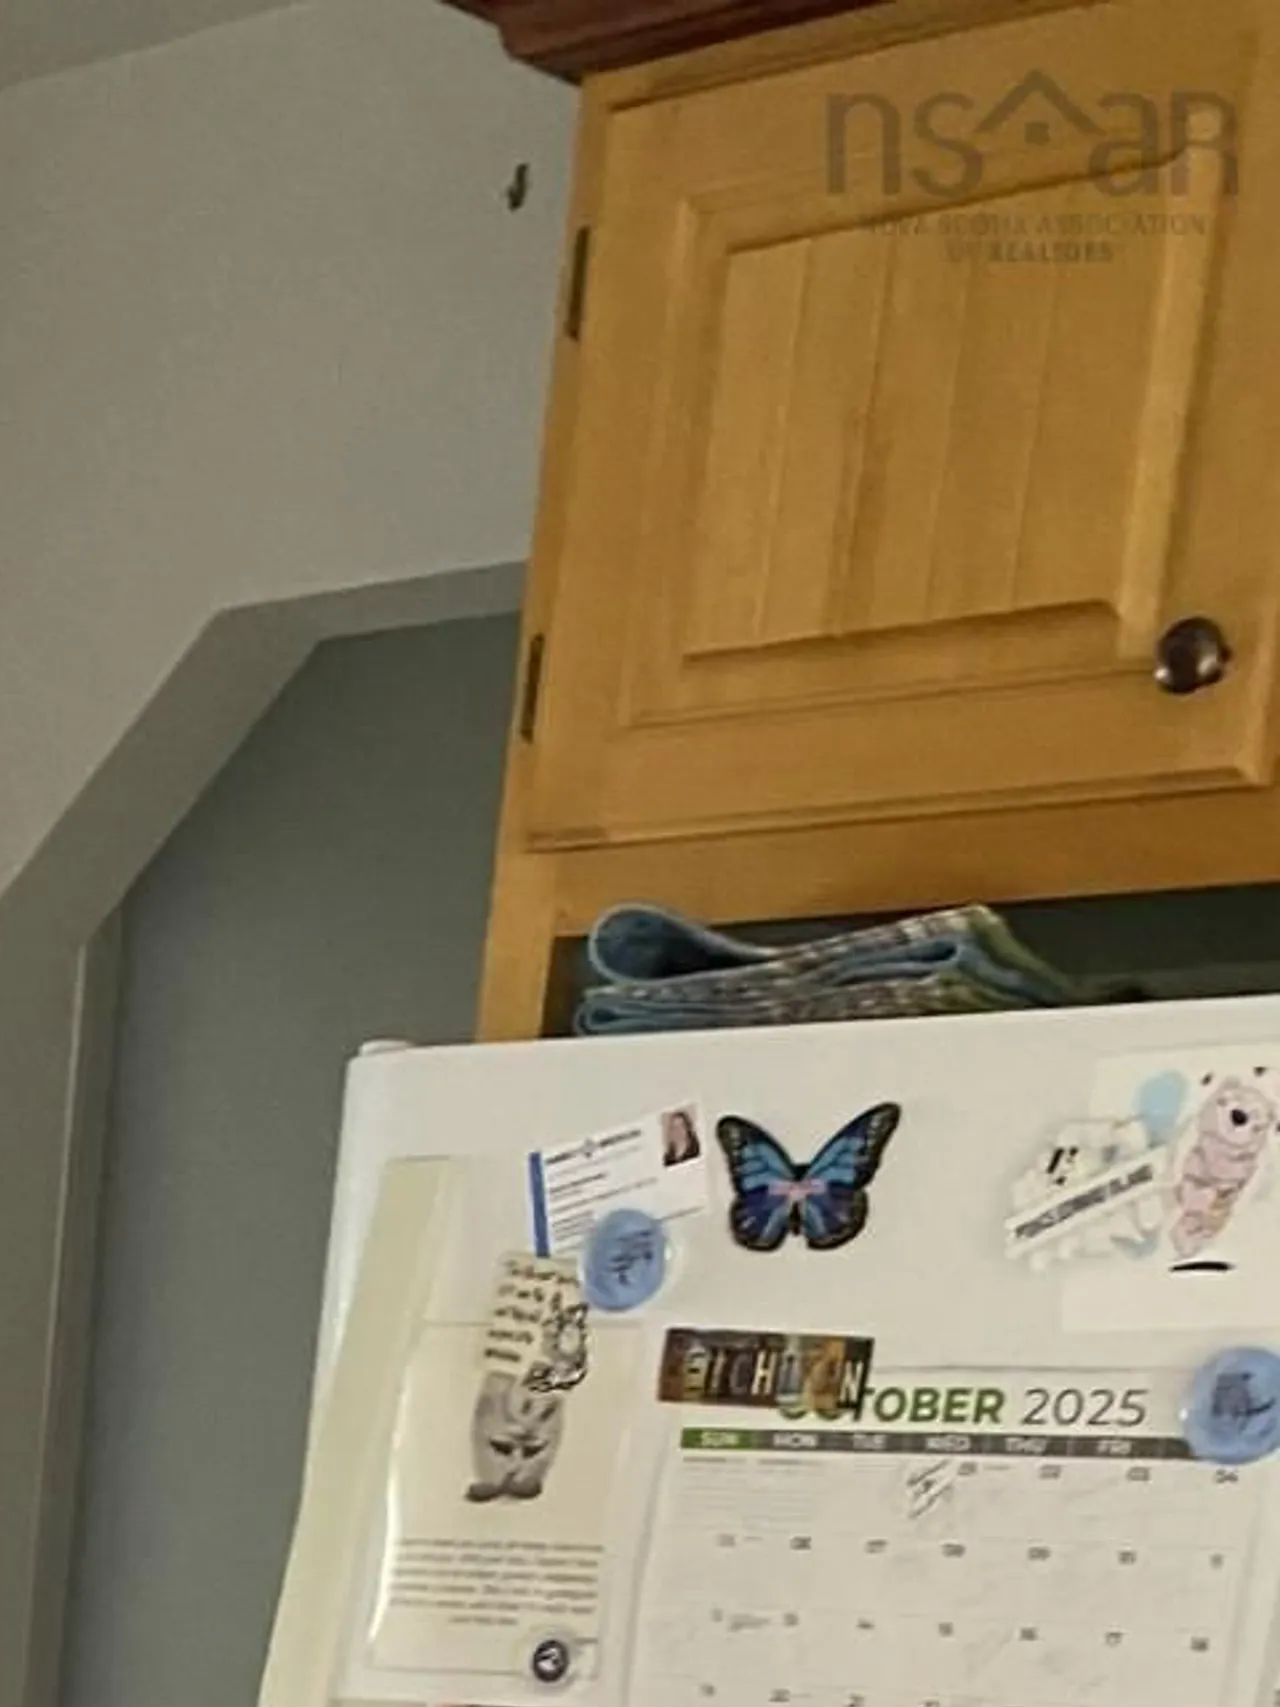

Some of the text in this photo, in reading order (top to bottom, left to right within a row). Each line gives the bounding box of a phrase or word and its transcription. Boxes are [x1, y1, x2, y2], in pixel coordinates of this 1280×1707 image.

[1020, 1386, 1151, 1428] 2025
[700, 1431, 1132, 1456] SUN MON TUE WED THU FRI
